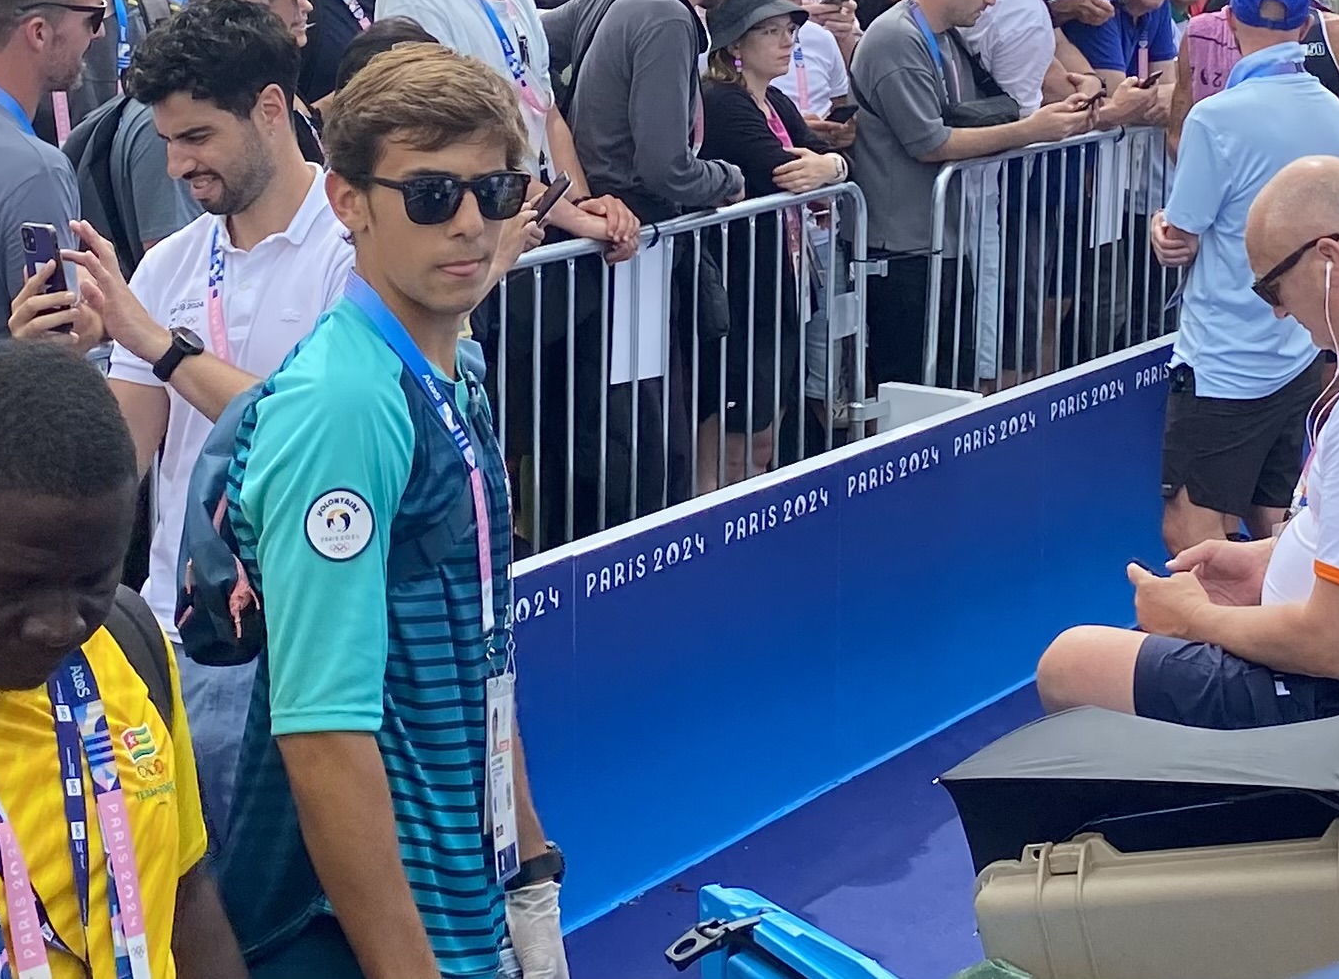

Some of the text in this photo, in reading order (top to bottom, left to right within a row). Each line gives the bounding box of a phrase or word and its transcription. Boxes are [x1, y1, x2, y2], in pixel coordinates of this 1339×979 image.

[1091, 379, 1124, 406] 2024
[999, 411, 1036, 441] 2024
[898, 450, 940, 480] 2024
[317, 498, 361, 518] VOLONTAIRE
[783, 487, 829, 523] 2024
[653, 532, 705, 572] 2024
[514, 586, 560, 623] 024
[107, 803, 139, 928] PARIS 2024
[15, 898, 36, 959] PARIS
